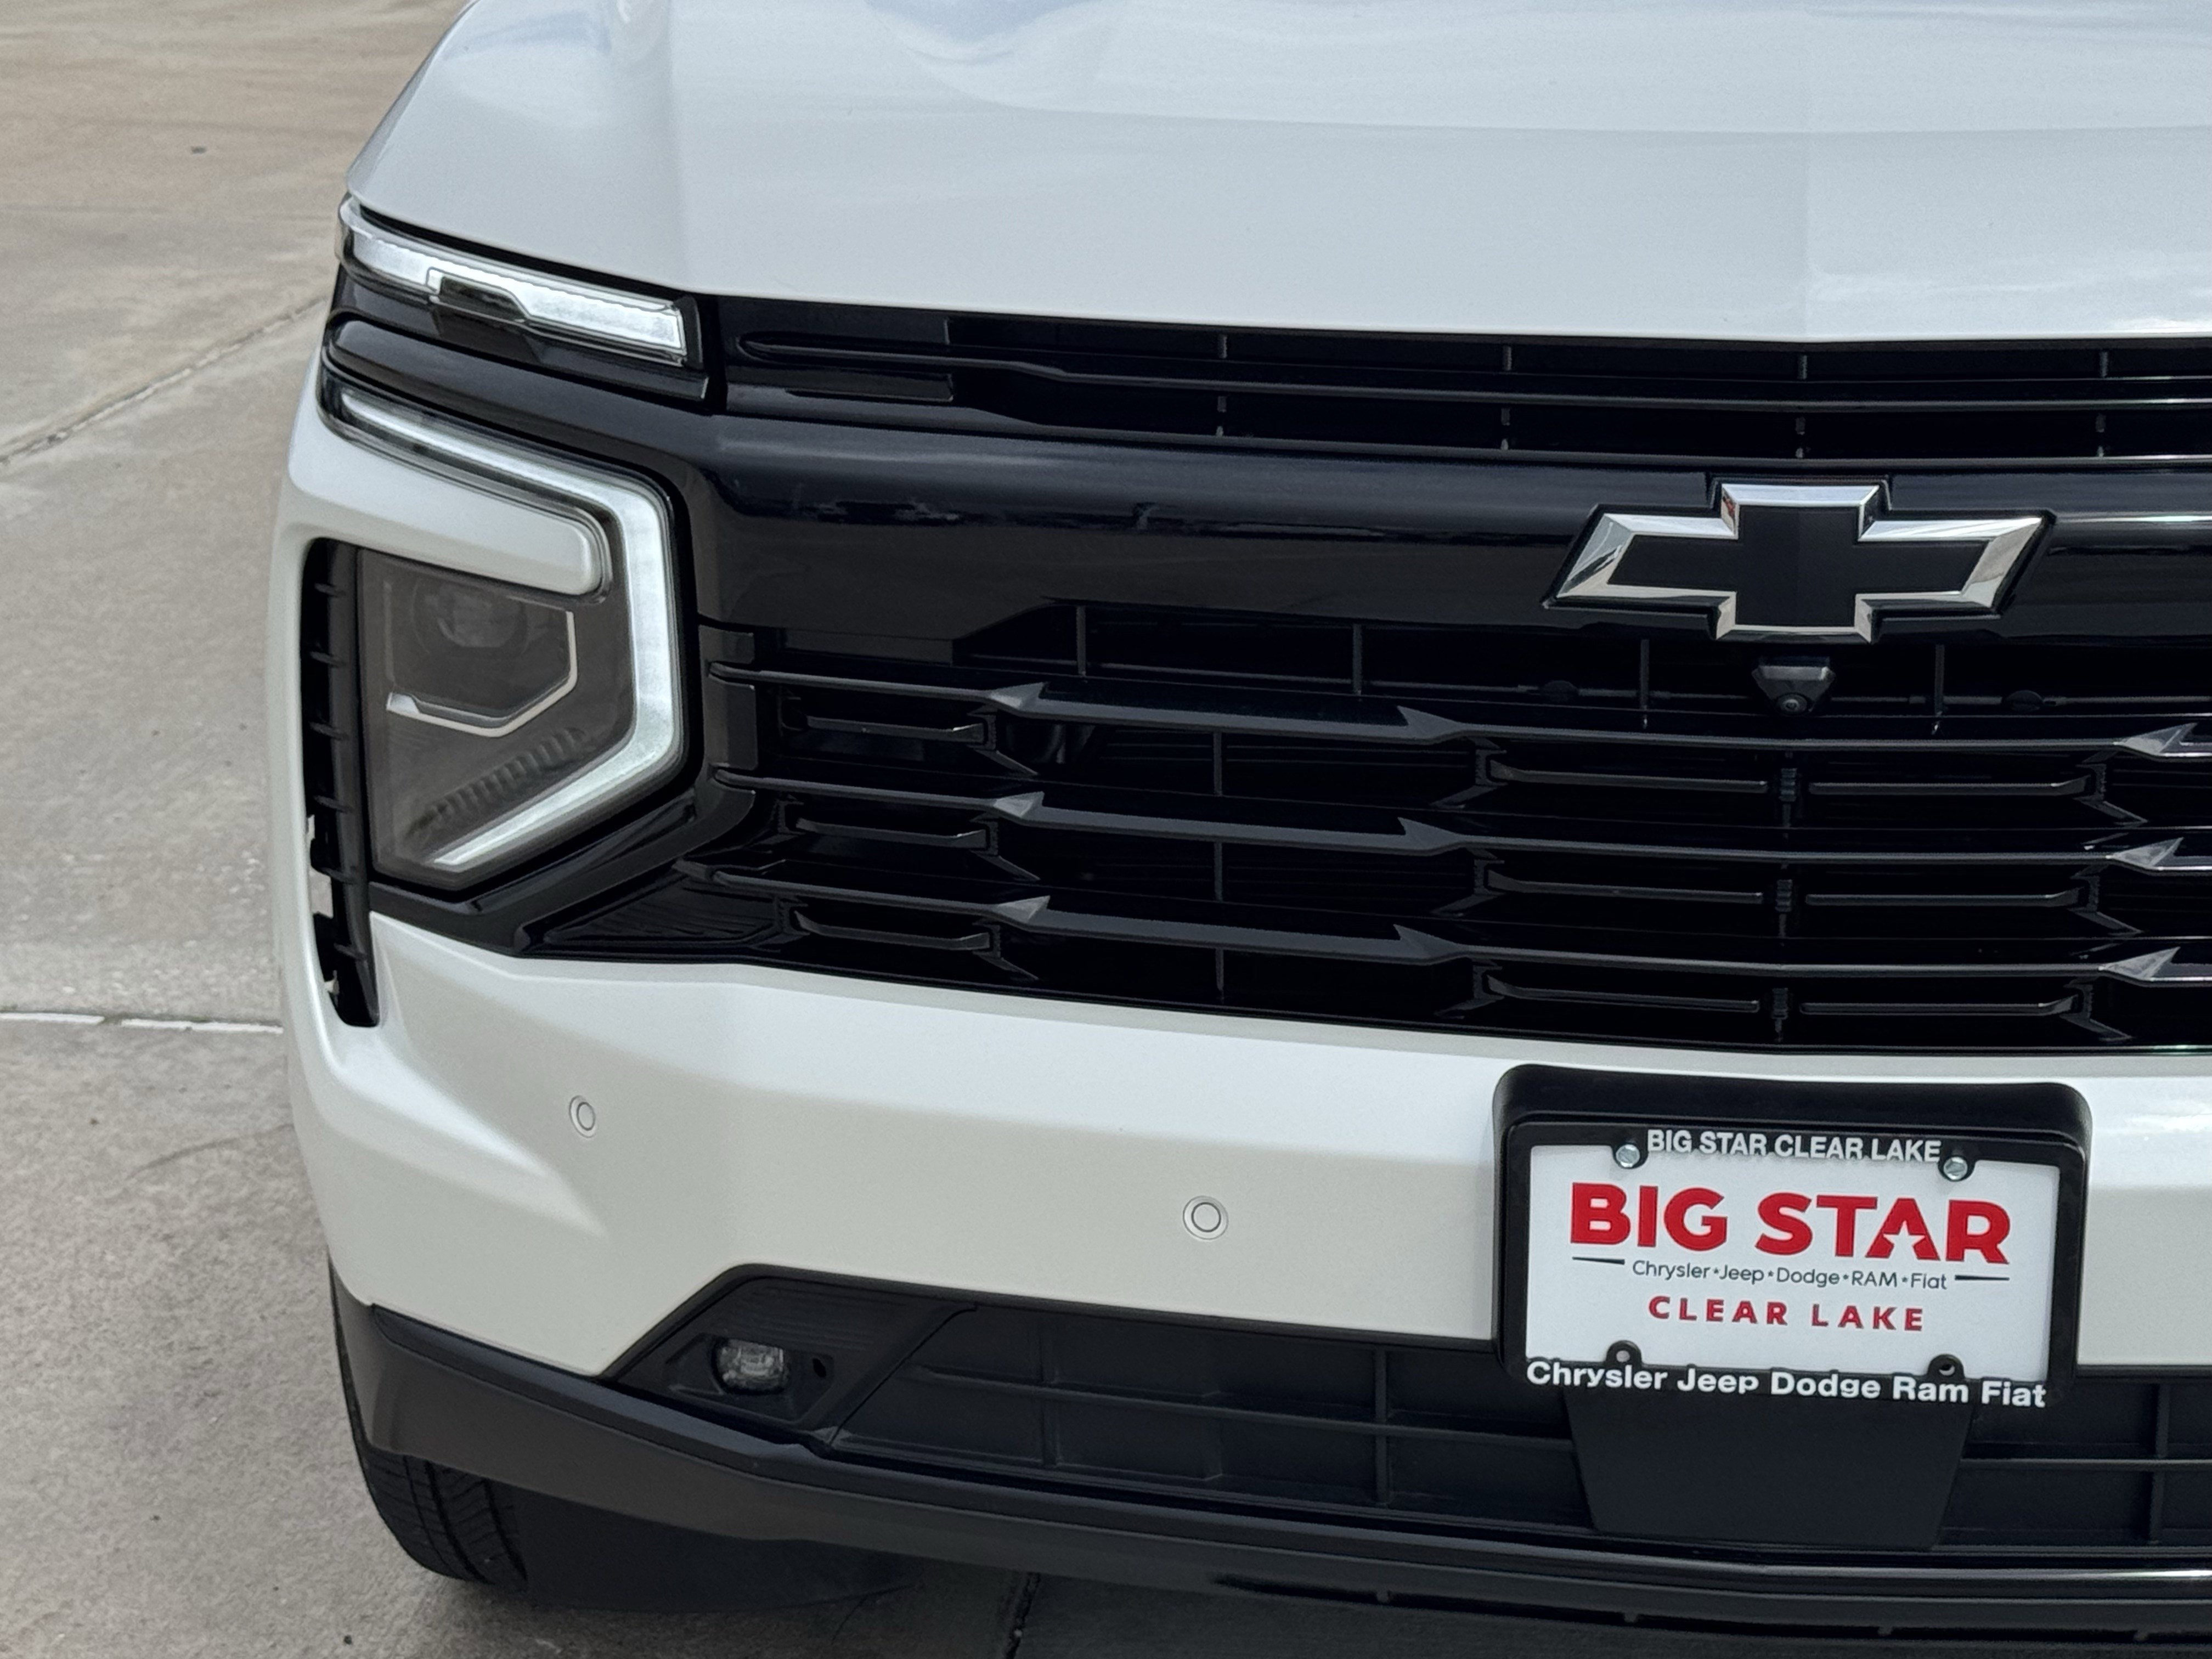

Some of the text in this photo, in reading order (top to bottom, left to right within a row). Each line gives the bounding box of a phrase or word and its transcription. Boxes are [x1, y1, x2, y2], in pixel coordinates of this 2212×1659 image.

[1647, 1129, 1942, 1163] BIG STAR CLEAR LAKE
[1570, 1182, 2011, 1264] BIG STAR
[1648, 1296, 1923, 1331] CLEAR LAKE
[1527, 1361, 2047, 1408] Chrysler Jeep Dodge Ram Fiat
